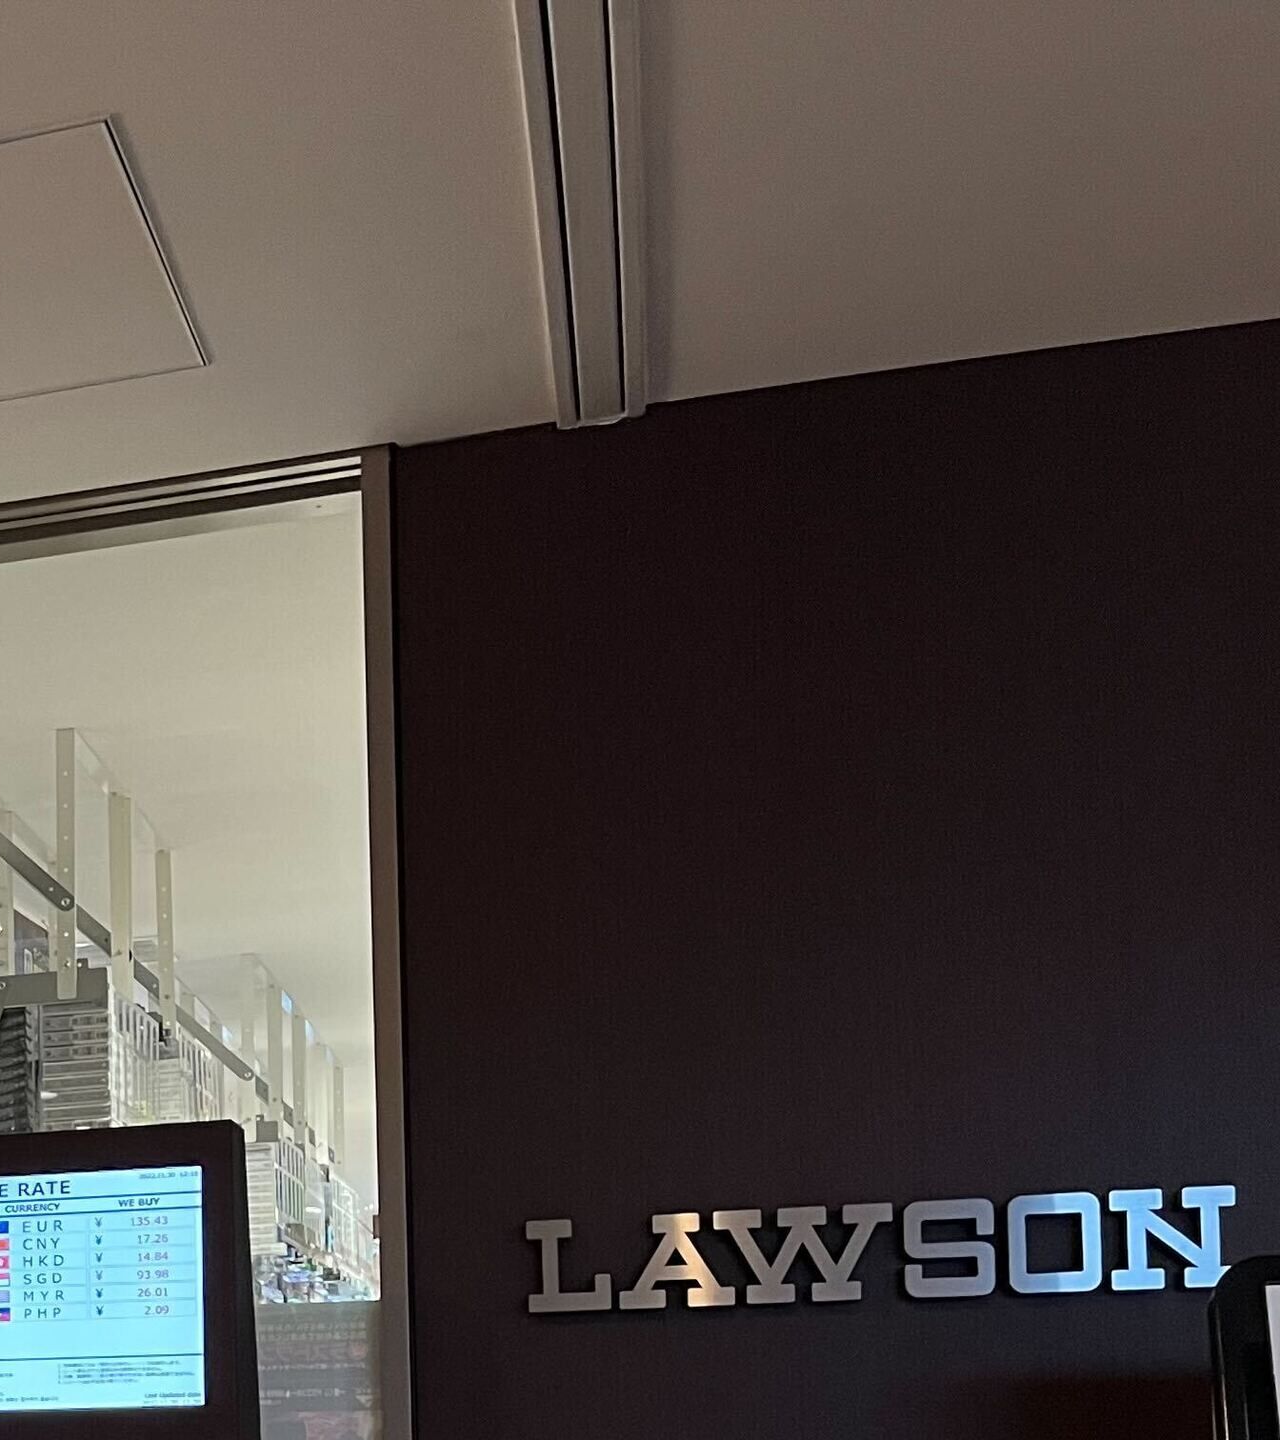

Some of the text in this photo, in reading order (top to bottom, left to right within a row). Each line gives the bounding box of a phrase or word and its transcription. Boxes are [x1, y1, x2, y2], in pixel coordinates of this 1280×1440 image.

[18, 1180, 71, 1197] RATE
[5, 1198, 160, 1213] CURRENCY WE BUY
[23, 1220, 63, 1233] EUR
[23, 1238, 60, 1250] CNY
[525, 1185, 1236, 1313] LAWSON
[23, 1255, 64, 1267] HKD
[23, 1273, 62, 1285] SGD
[23, 1290, 64, 1301] MYR
[24, 1308, 61, 1319] PHP
